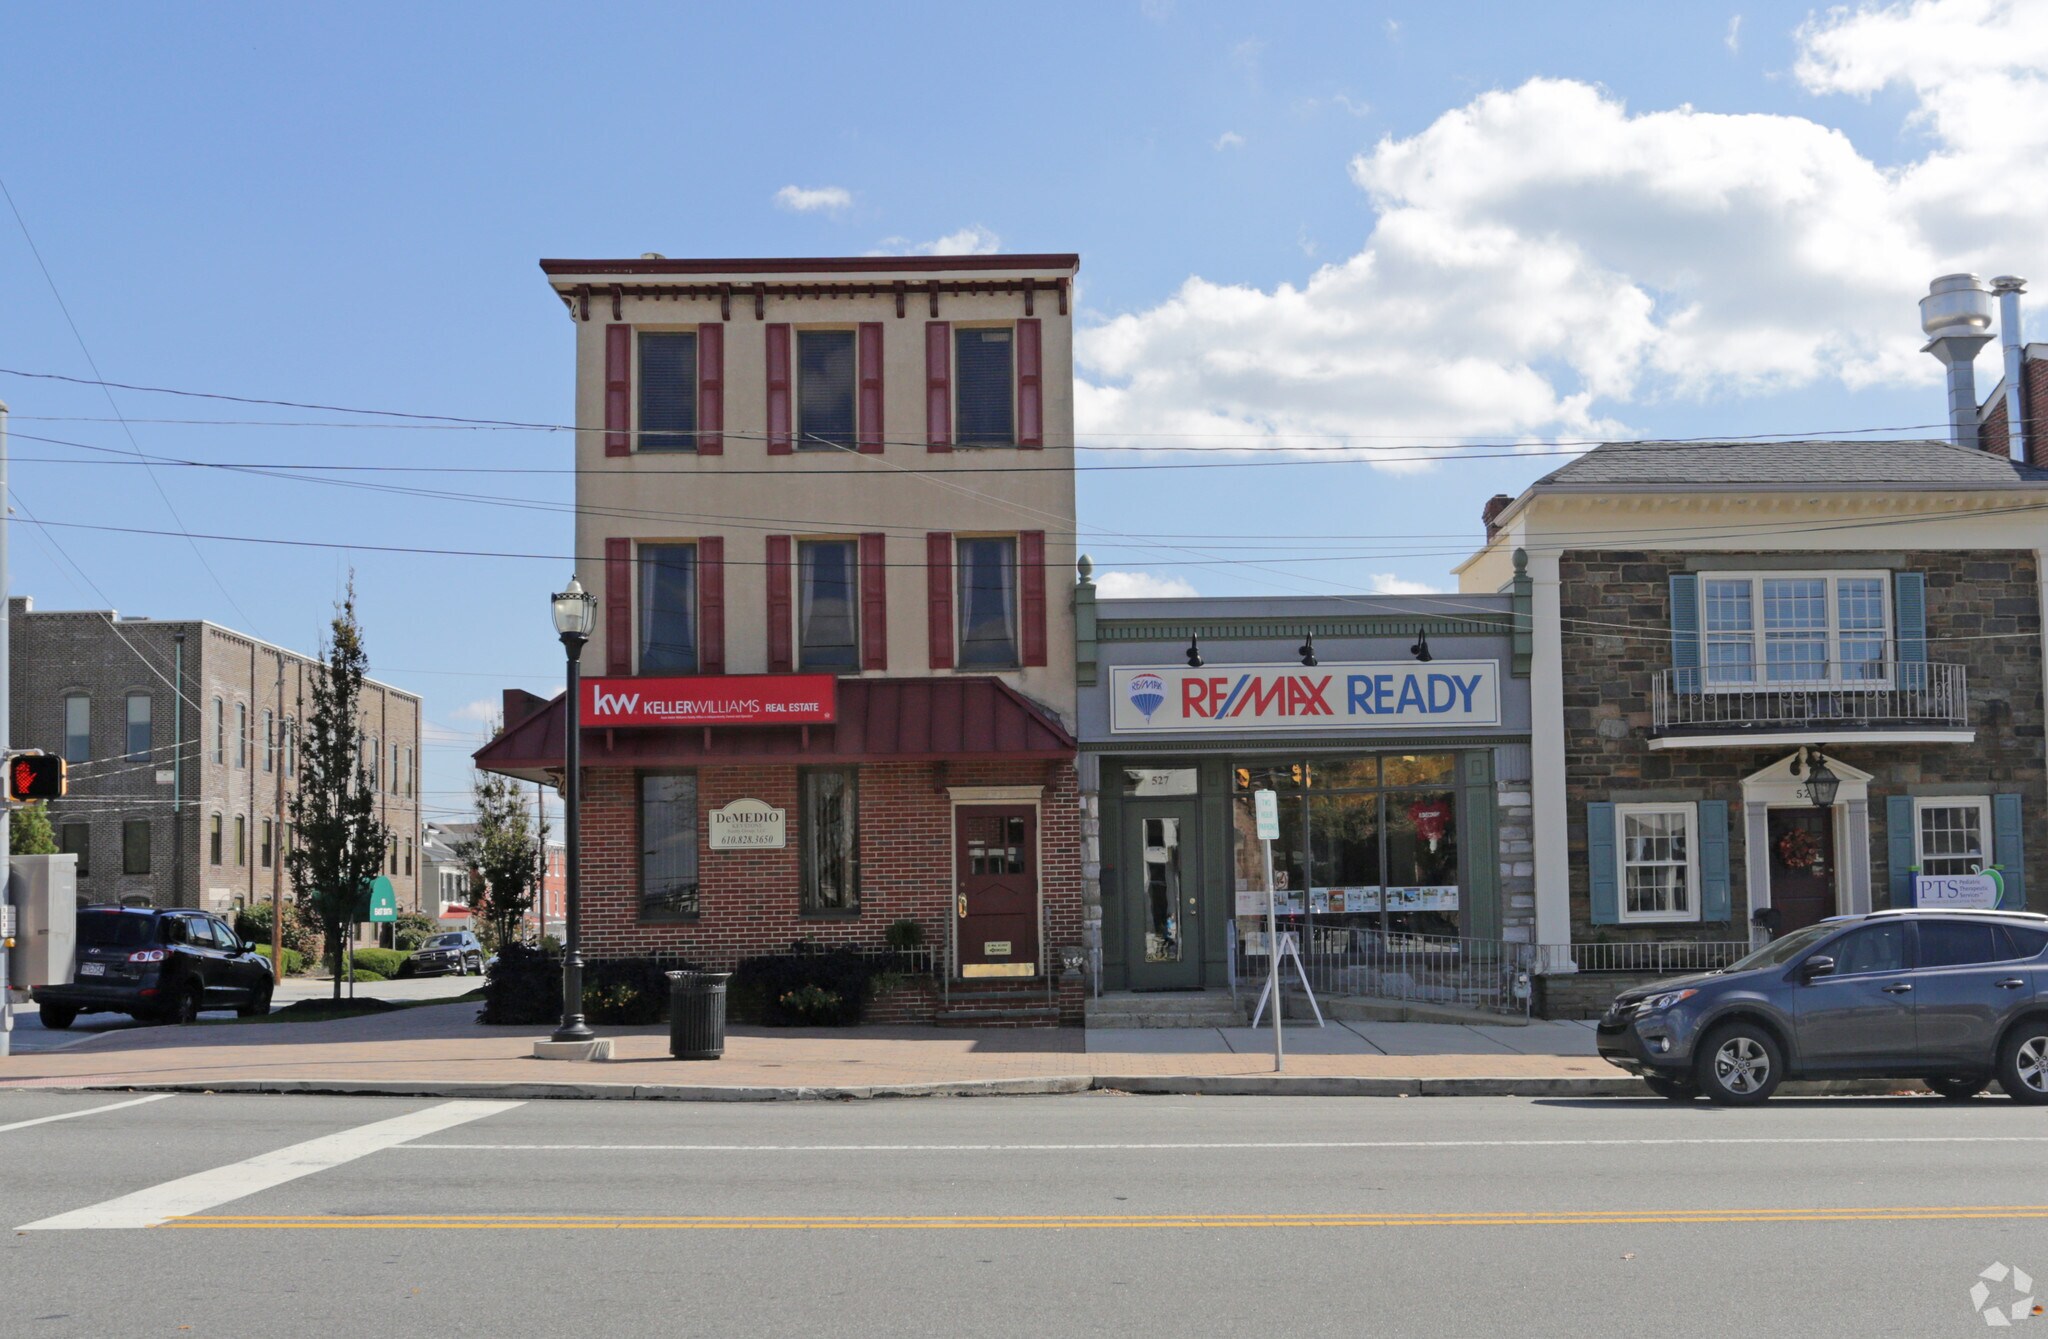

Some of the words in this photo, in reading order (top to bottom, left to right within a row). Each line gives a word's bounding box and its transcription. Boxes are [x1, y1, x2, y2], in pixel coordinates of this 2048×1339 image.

[1131, 679, 1162, 691] RE/MAX
[594, 684, 640, 715] kw
[765, 703, 787, 713] REAL
[788, 702, 819, 713] ESTATE
[1181, 674, 1334, 720] RE/MAX
[1347, 674, 1483, 715] READY
[1151, 775, 1169, 786] 527
[716, 812, 779, 824] DeMEDIO
[721, 834, 774, 845] 610.828.3650
[1920, 879, 1959, 899] PTS
